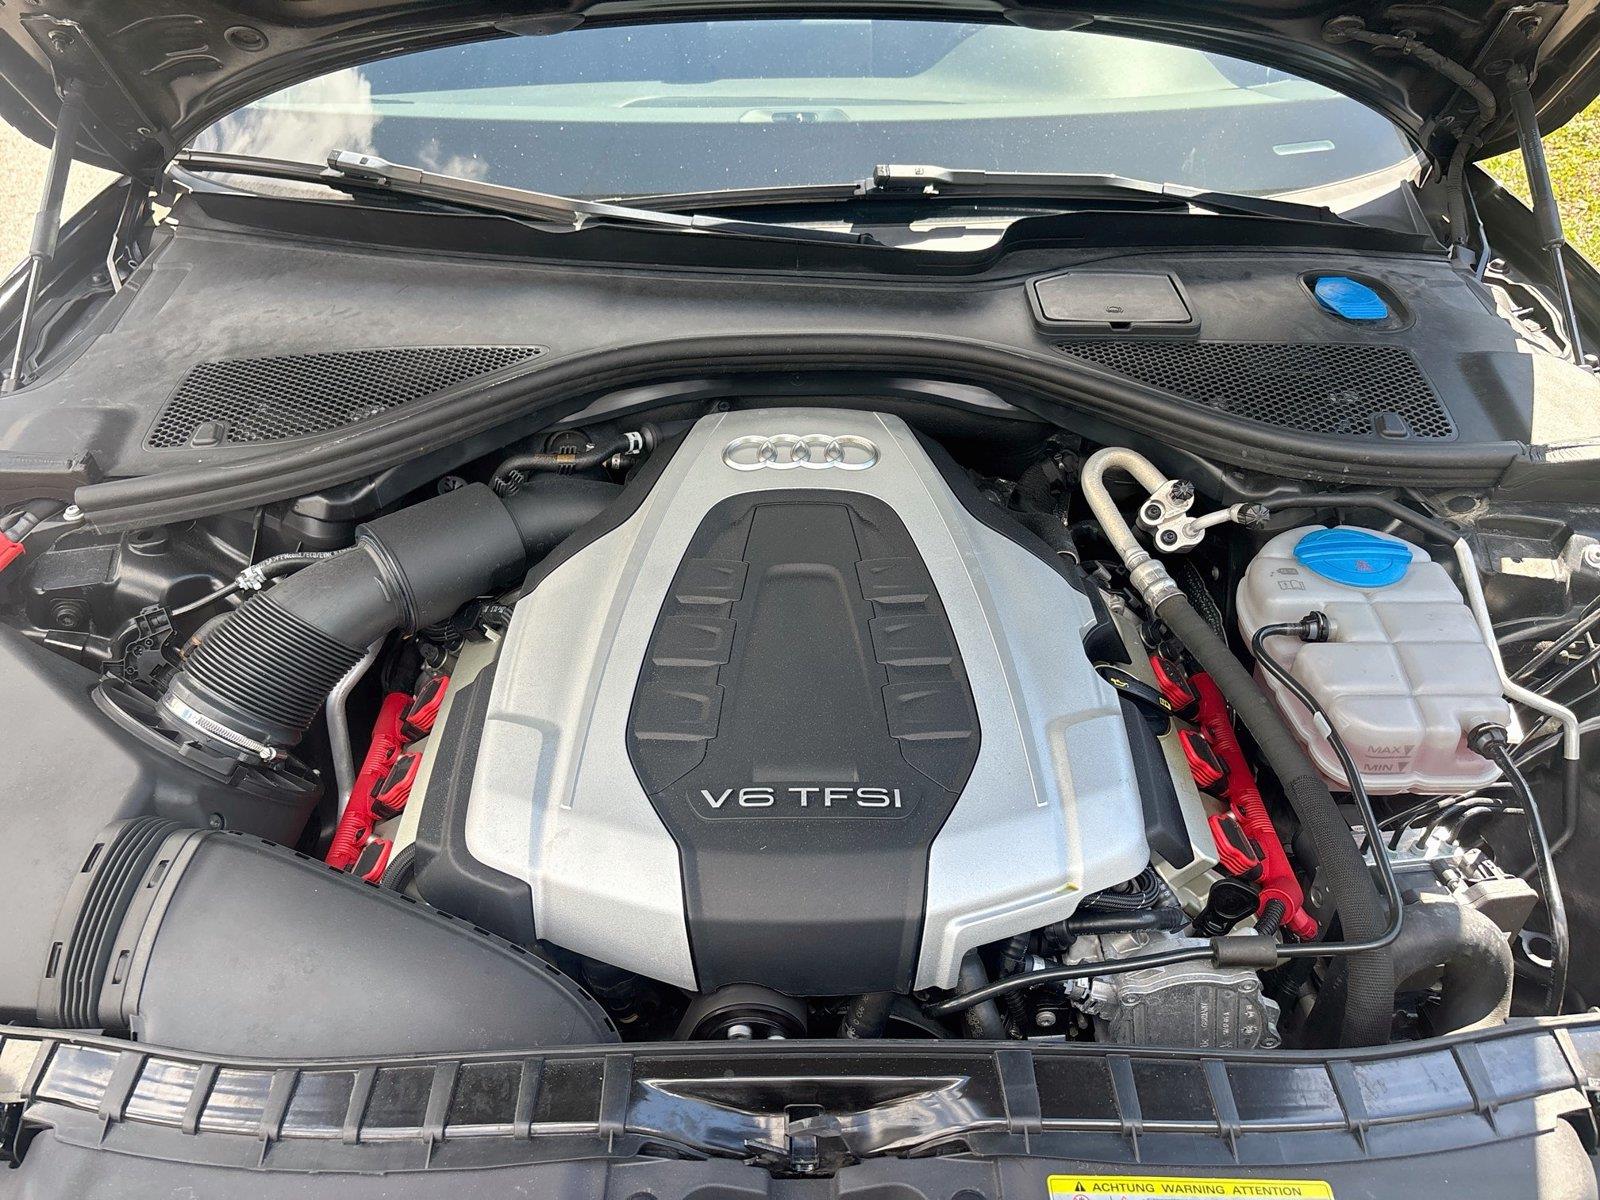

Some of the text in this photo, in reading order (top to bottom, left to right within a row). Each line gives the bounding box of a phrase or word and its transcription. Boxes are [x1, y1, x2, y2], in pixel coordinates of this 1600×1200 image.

[1368, 745, 1400, 754] MAX
[1364, 763, 1393, 772] MIN
[701, 787, 902, 808] V6 TFSI
[1092, 1182, 1301, 1196] ACHTUNG WARNING ATTENTION
